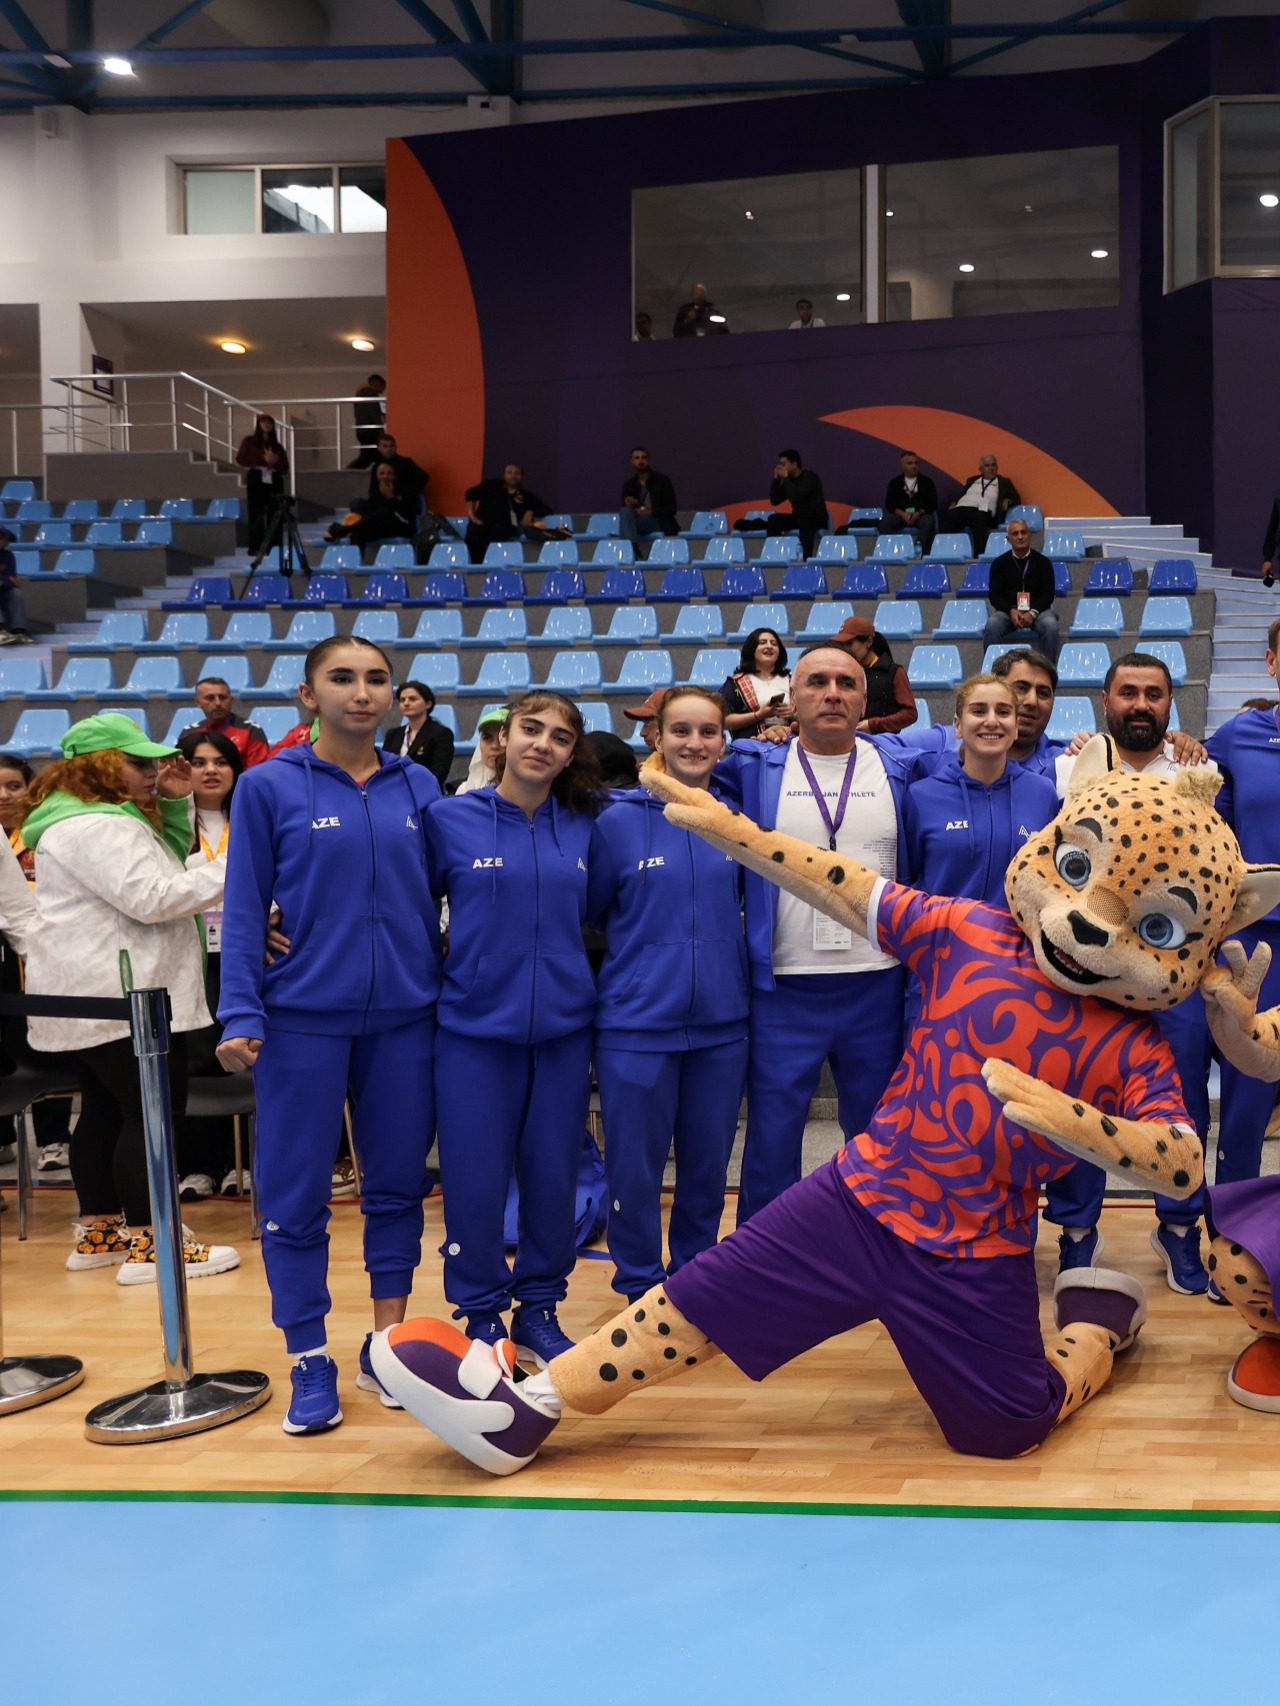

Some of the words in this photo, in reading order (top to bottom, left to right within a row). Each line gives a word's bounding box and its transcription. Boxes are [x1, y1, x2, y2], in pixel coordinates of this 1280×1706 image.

[786, 790, 838, 798] AZERBJAN
[312, 816, 340, 829] AZE
[945, 820, 969, 831] AZE
[472, 857, 504, 870] AZE
